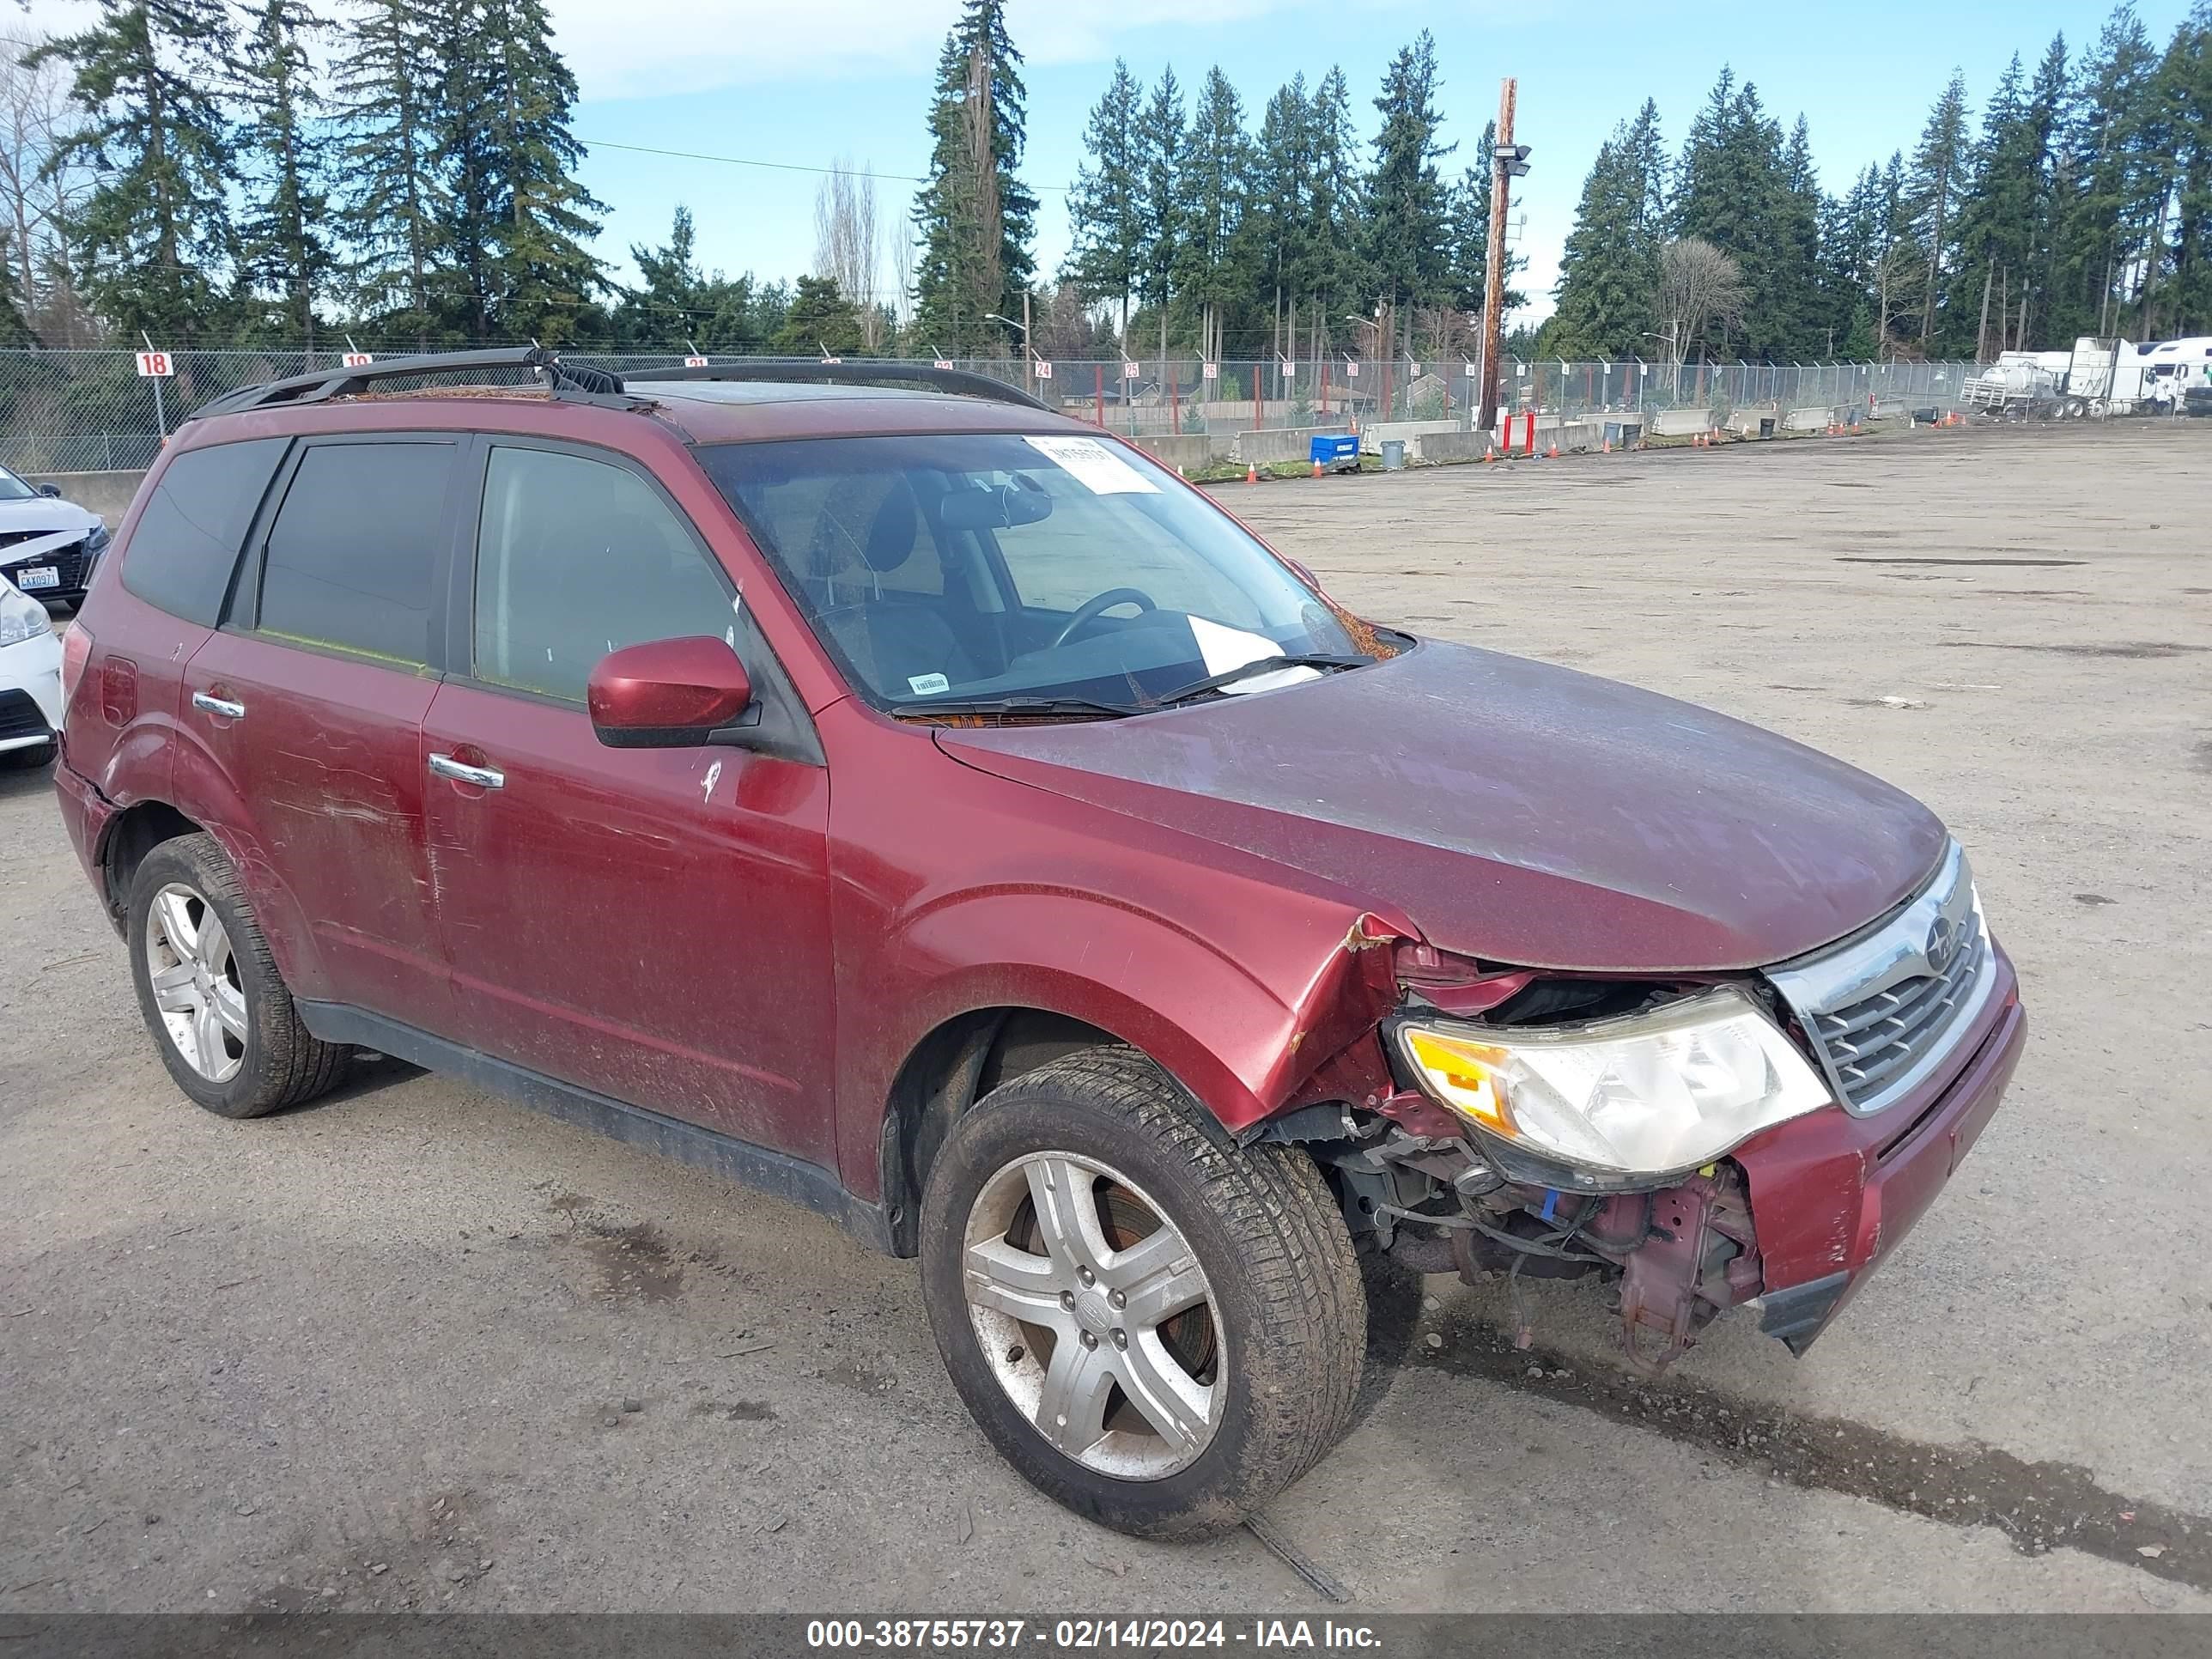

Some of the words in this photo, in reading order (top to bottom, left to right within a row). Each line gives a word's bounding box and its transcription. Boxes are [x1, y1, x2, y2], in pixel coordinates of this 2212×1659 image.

[143, 354, 167, 374] 18
[1037, 363, 1049, 377] 24
[1127, 364, 1138, 377] 25
[1284, 362, 1293, 374] 27
[1205, 365, 1215, 377] 26
